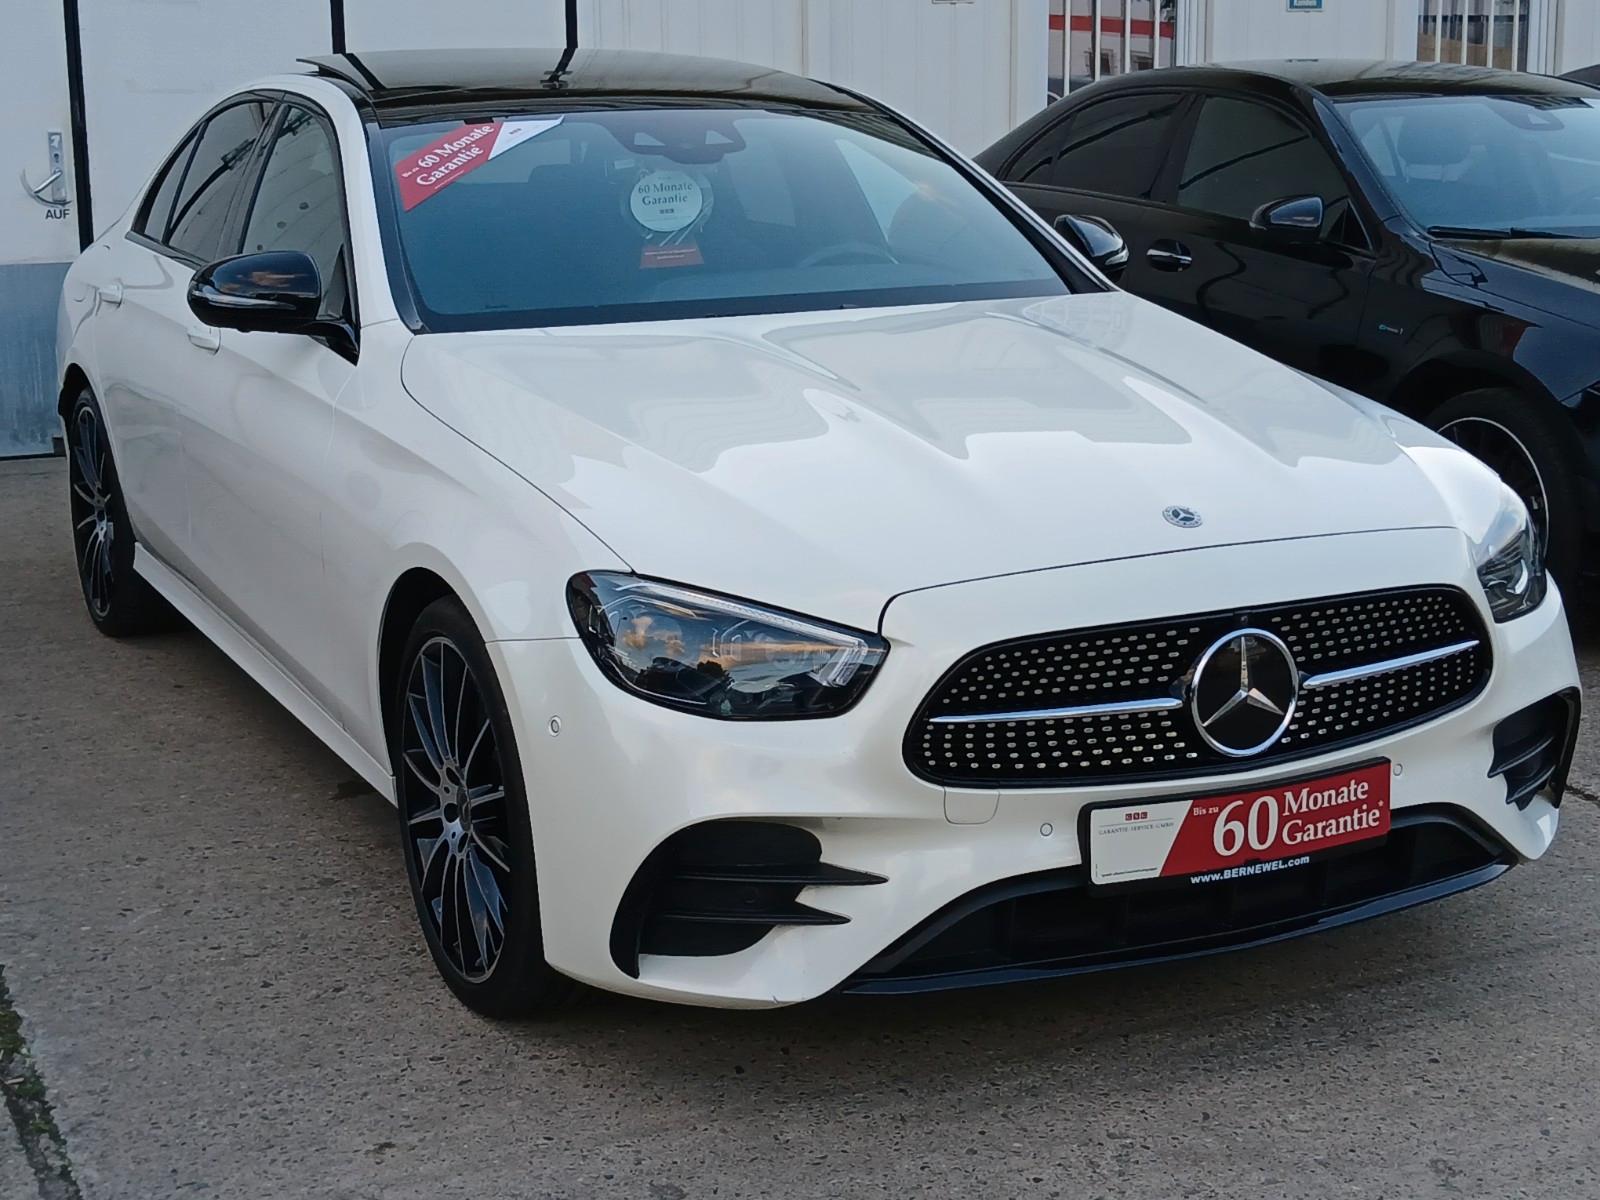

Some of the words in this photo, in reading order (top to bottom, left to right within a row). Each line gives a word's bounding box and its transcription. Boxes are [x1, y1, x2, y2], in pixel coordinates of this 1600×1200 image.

[418, 154, 441, 168] 60
[433, 125, 495, 157] Monate
[638, 184, 651, 194] 60
[653, 182, 693, 193] Monate
[641, 192, 688, 206] Garantie
[45, 208, 70, 220] AUF
[1282, 779, 1369, 816] Monate
[1193, 806, 1206, 816] Bis
[1208, 806, 1219, 814] zu
[1213, 795, 1279, 857] 60
[1190, 855, 1310, 884] www.BERNEWEL.com
